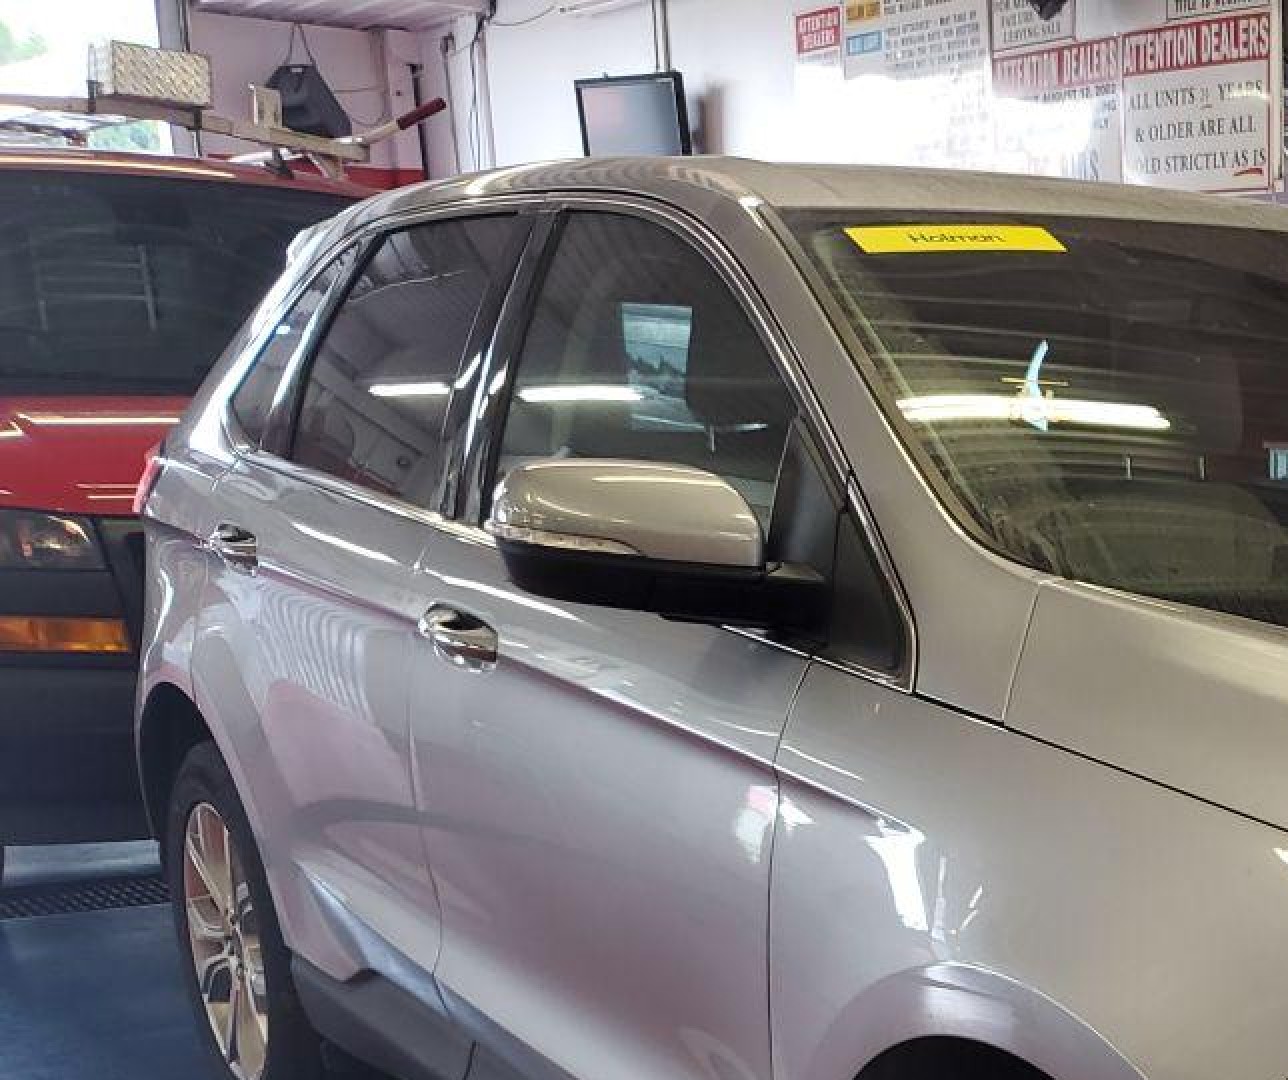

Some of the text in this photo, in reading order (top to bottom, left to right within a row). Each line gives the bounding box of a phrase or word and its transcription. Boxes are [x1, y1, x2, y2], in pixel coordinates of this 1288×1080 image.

[1124, 14, 1269, 73] ATTENTION DEALERS
[1064, 41, 1117, 85] DEALERS
[1130, 92, 1152, 111] ALL
[1155, 86, 1195, 109] UNITS
[1218, 79, 1263, 101] YEARS
[1147, 120, 1195, 142] OLDER
[1198, 118, 1225, 140] ARE
[1229, 114, 1257, 135] ALL
[1165, 151, 1229, 175] STRICTLY
